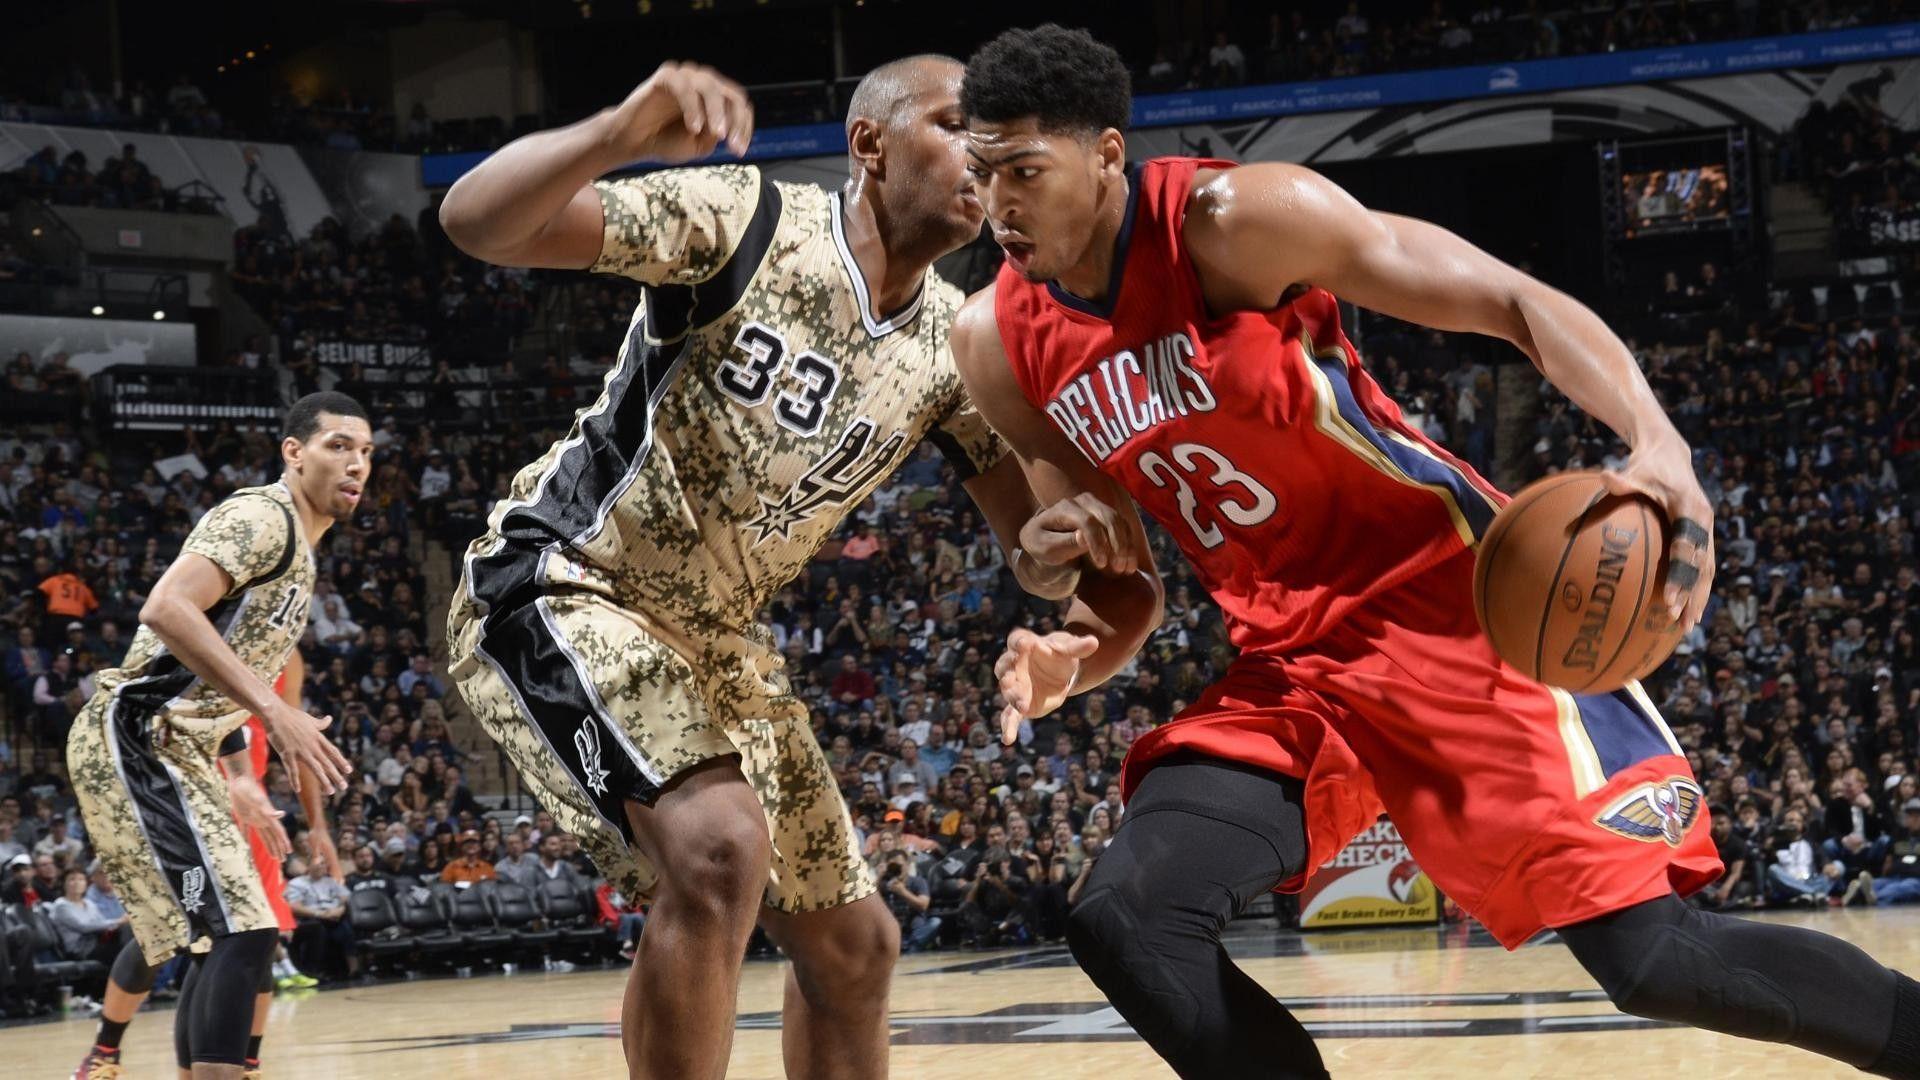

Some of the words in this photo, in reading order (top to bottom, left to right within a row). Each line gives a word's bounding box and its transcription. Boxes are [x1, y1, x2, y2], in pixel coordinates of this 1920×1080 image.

[1144, 105, 1217, 121] BUSINESSES
[1232, 98, 1294, 113] FINANCIAL
[1300, 90, 1381, 106] INSTITUTIONS
[1726, 51, 1804, 67] BUSINESSES
[1821, 42, 1888, 57] FINANCIAL
[714, 320, 841, 438] 33
[1046, 332, 1217, 468] PELICANS
[1137, 443, 1278, 550] 23
[1561, 522, 1639, 673] SPALDING
[1316, 910, 1339, 920] Fast
[1341, 908, 1375, 919] Brakes
[1378, 906, 1406, 919] Every
[1407, 906, 1431, 917] Day!
